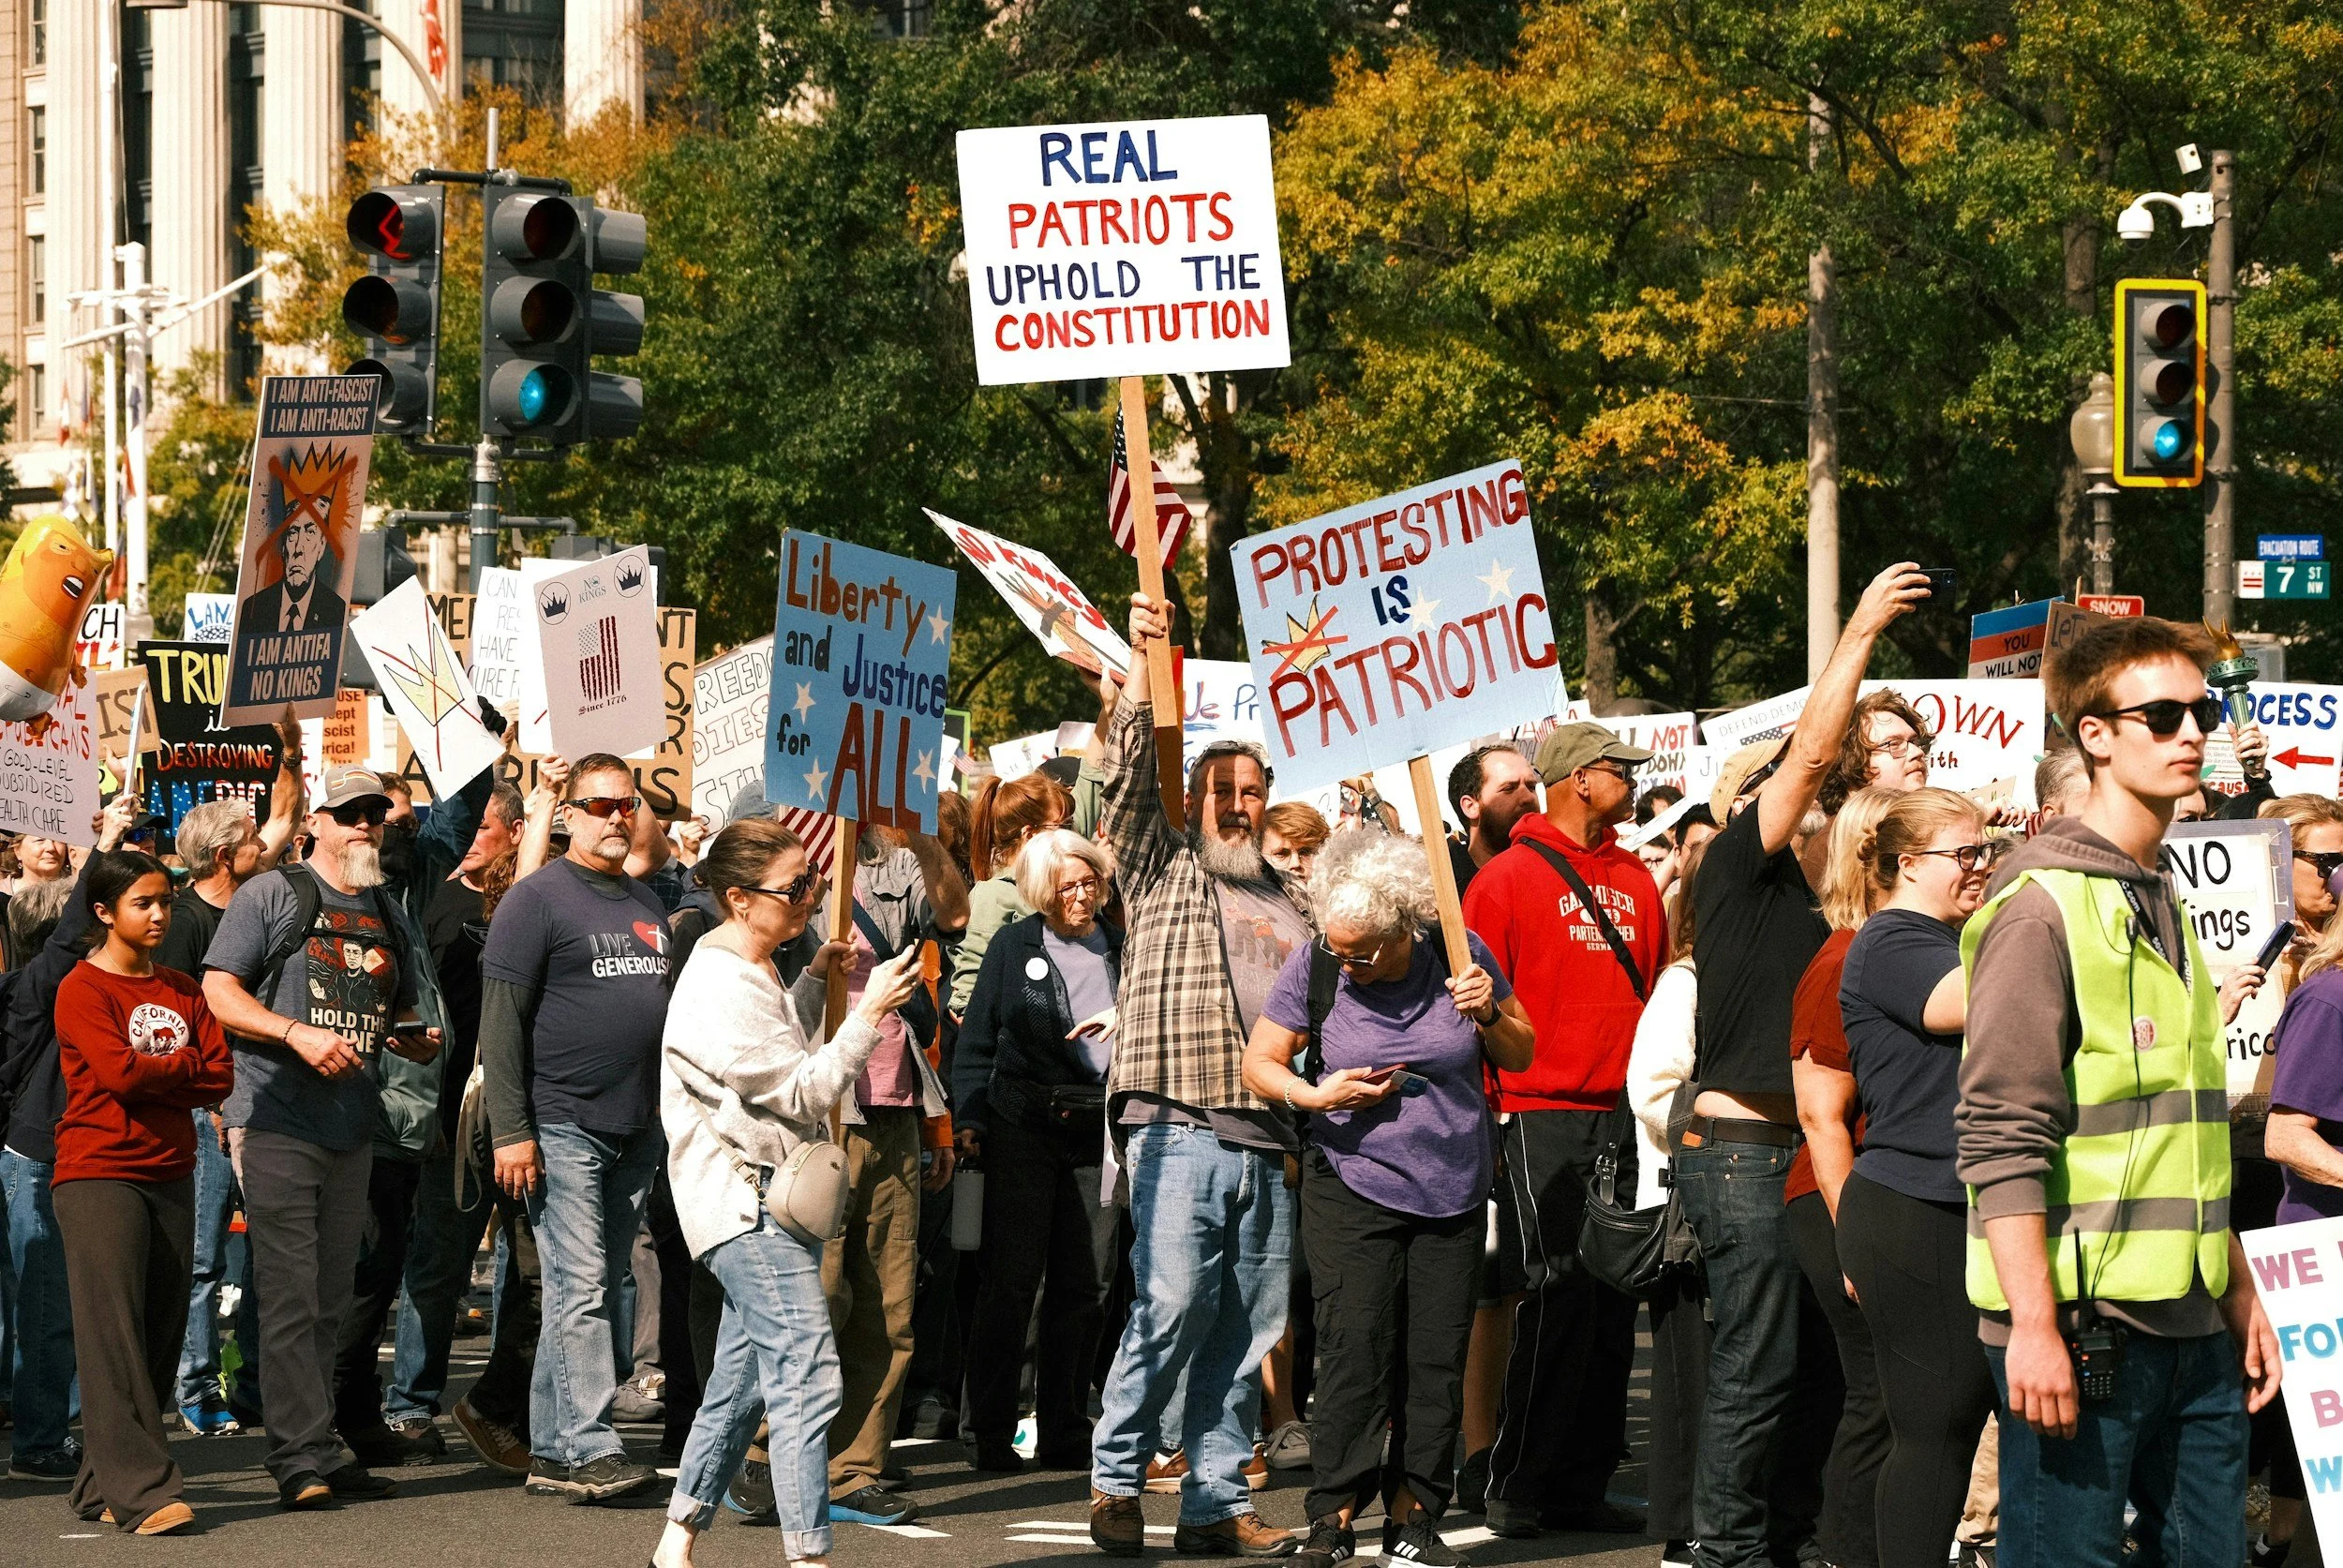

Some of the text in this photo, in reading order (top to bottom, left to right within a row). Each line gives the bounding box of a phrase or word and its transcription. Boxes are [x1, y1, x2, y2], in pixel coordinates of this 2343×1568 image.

[1039, 129, 1178, 187] REAL
[1008, 192, 1234, 248] PATRIOTS
[986, 253, 1261, 306] UPHOLD THE
[995, 299, 1270, 351] CONSTITUTION
[271, 378, 376, 403] I AM ANTI-FASCIST
[270, 406, 369, 432] I AM ANTI-RACIST
[1250, 469, 1529, 609] PROTESTING
[2260, 540, 2320, 556] EVACUATION ROUTE
[956, 527, 1107, 631] NO KINGS
[2276, 566, 2322, 593] 7 ST
[2307, 582, 2324, 593] NW
[578, 587, 606, 605] KINGS
[786, 539, 926, 657] Liberty
[1371, 575, 1412, 626] IS
[2090, 600, 2131, 615] SNOW
[246, 633, 331, 666] I AM ANTIFA
[2004, 633, 2030, 651] YOU
[145, 650, 228, 705] TRU
[249, 665, 322, 701] NO KINGS
[784, 625, 948, 719] and Justice
[1268, 592, 1559, 757] PATRIOTIC
[1985, 662, 2014, 679] WILL
[330, 707, 355, 722] ept
[578, 694, 627, 716] Since 1776
[1650, 724, 1688, 751] NOT
[1719, 713, 1768, 738] DEFEND
[4, 749, 73, 781] GOLD-LEVEL
[157, 738, 274, 771] DESTROYING
[777, 702, 921, 833] for ALL
[0, 773, 74, 804] UBSIDIZED
[32, 806, 67, 834] CARE
[1559, 885, 1636, 917] GAMISCH
[2182, 898, 2250, 950] ings
[588, 933, 635, 959] LIVE
[310, 1008, 386, 1034] HOLD THE
[2251, 1247, 2323, 1292] WE
